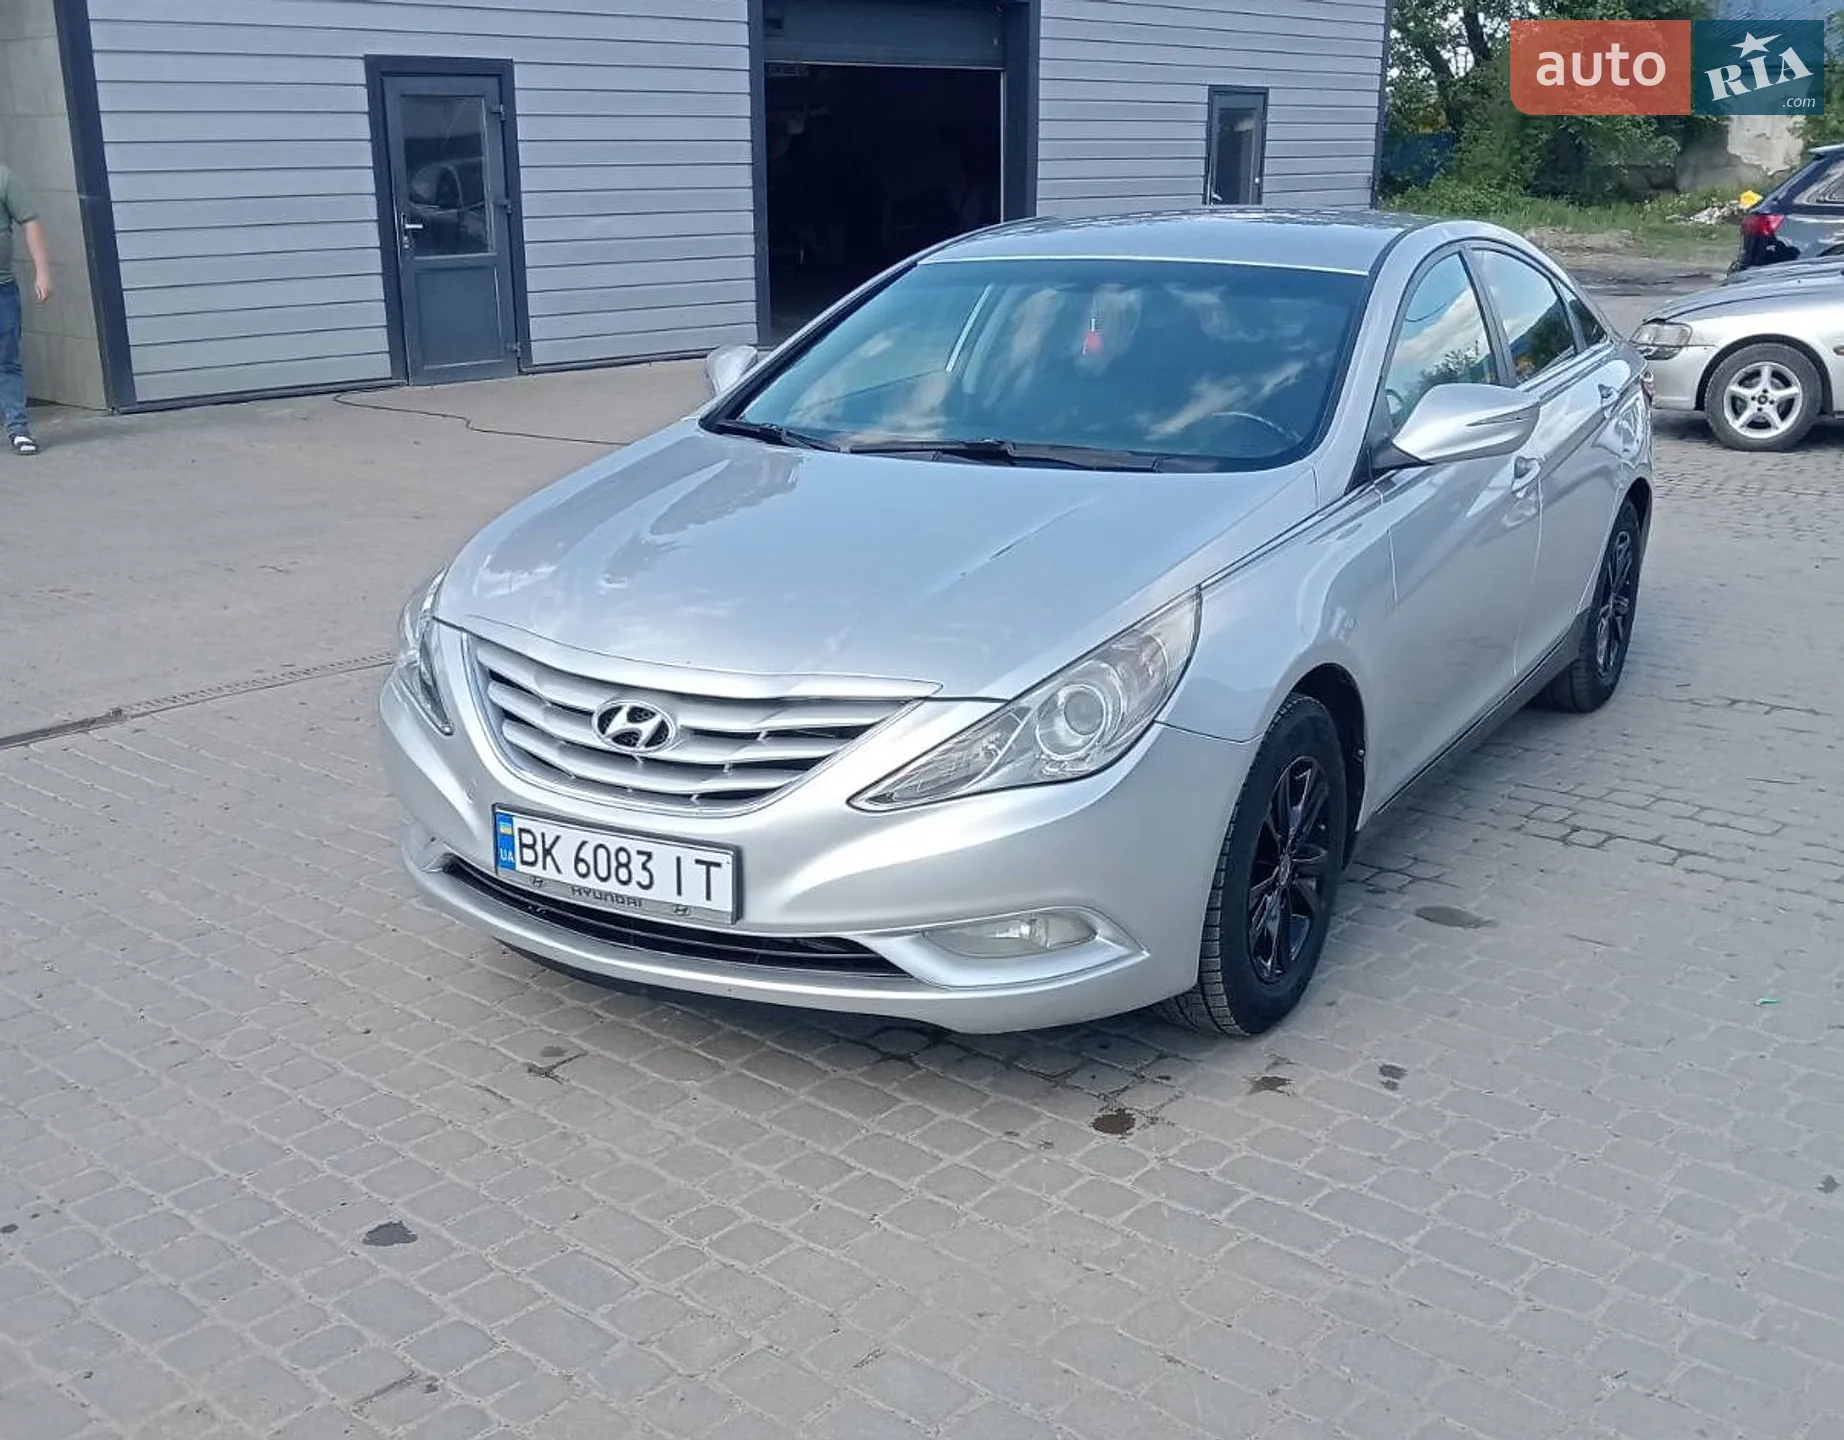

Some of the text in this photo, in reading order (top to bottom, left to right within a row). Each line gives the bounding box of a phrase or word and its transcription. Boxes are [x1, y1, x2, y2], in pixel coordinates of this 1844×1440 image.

[499, 849, 515, 863] UA
[517, 827, 723, 901] BK 6083 IT
[571, 886, 643, 907] HYUNDAI
